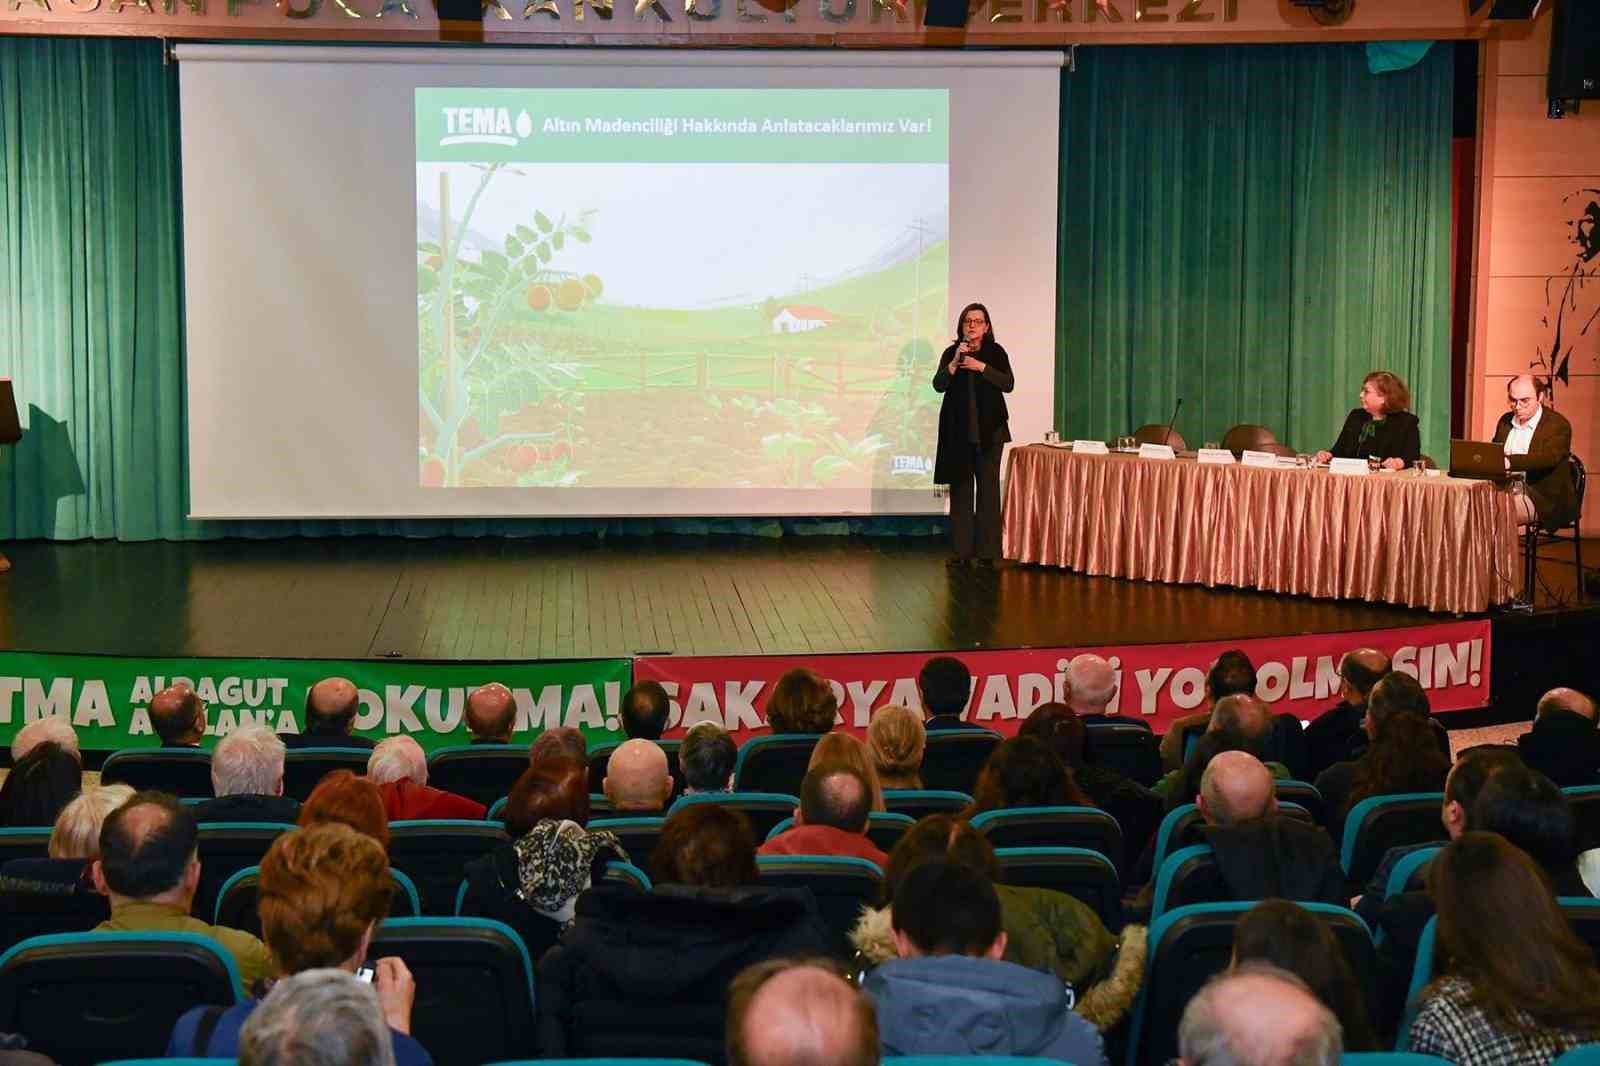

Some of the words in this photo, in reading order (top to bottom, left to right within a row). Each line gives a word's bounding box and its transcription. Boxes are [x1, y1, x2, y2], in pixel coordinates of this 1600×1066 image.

[443, 107, 513, 134] TEMA
[543, 117, 581, 133] Altın
[682, 118, 757, 133] Hakkında
[760, 118, 894, 133] Anlatacaklarımız
[304, 681, 621, 733] OKUMA!
[1135, 662, 1213, 714] YO
